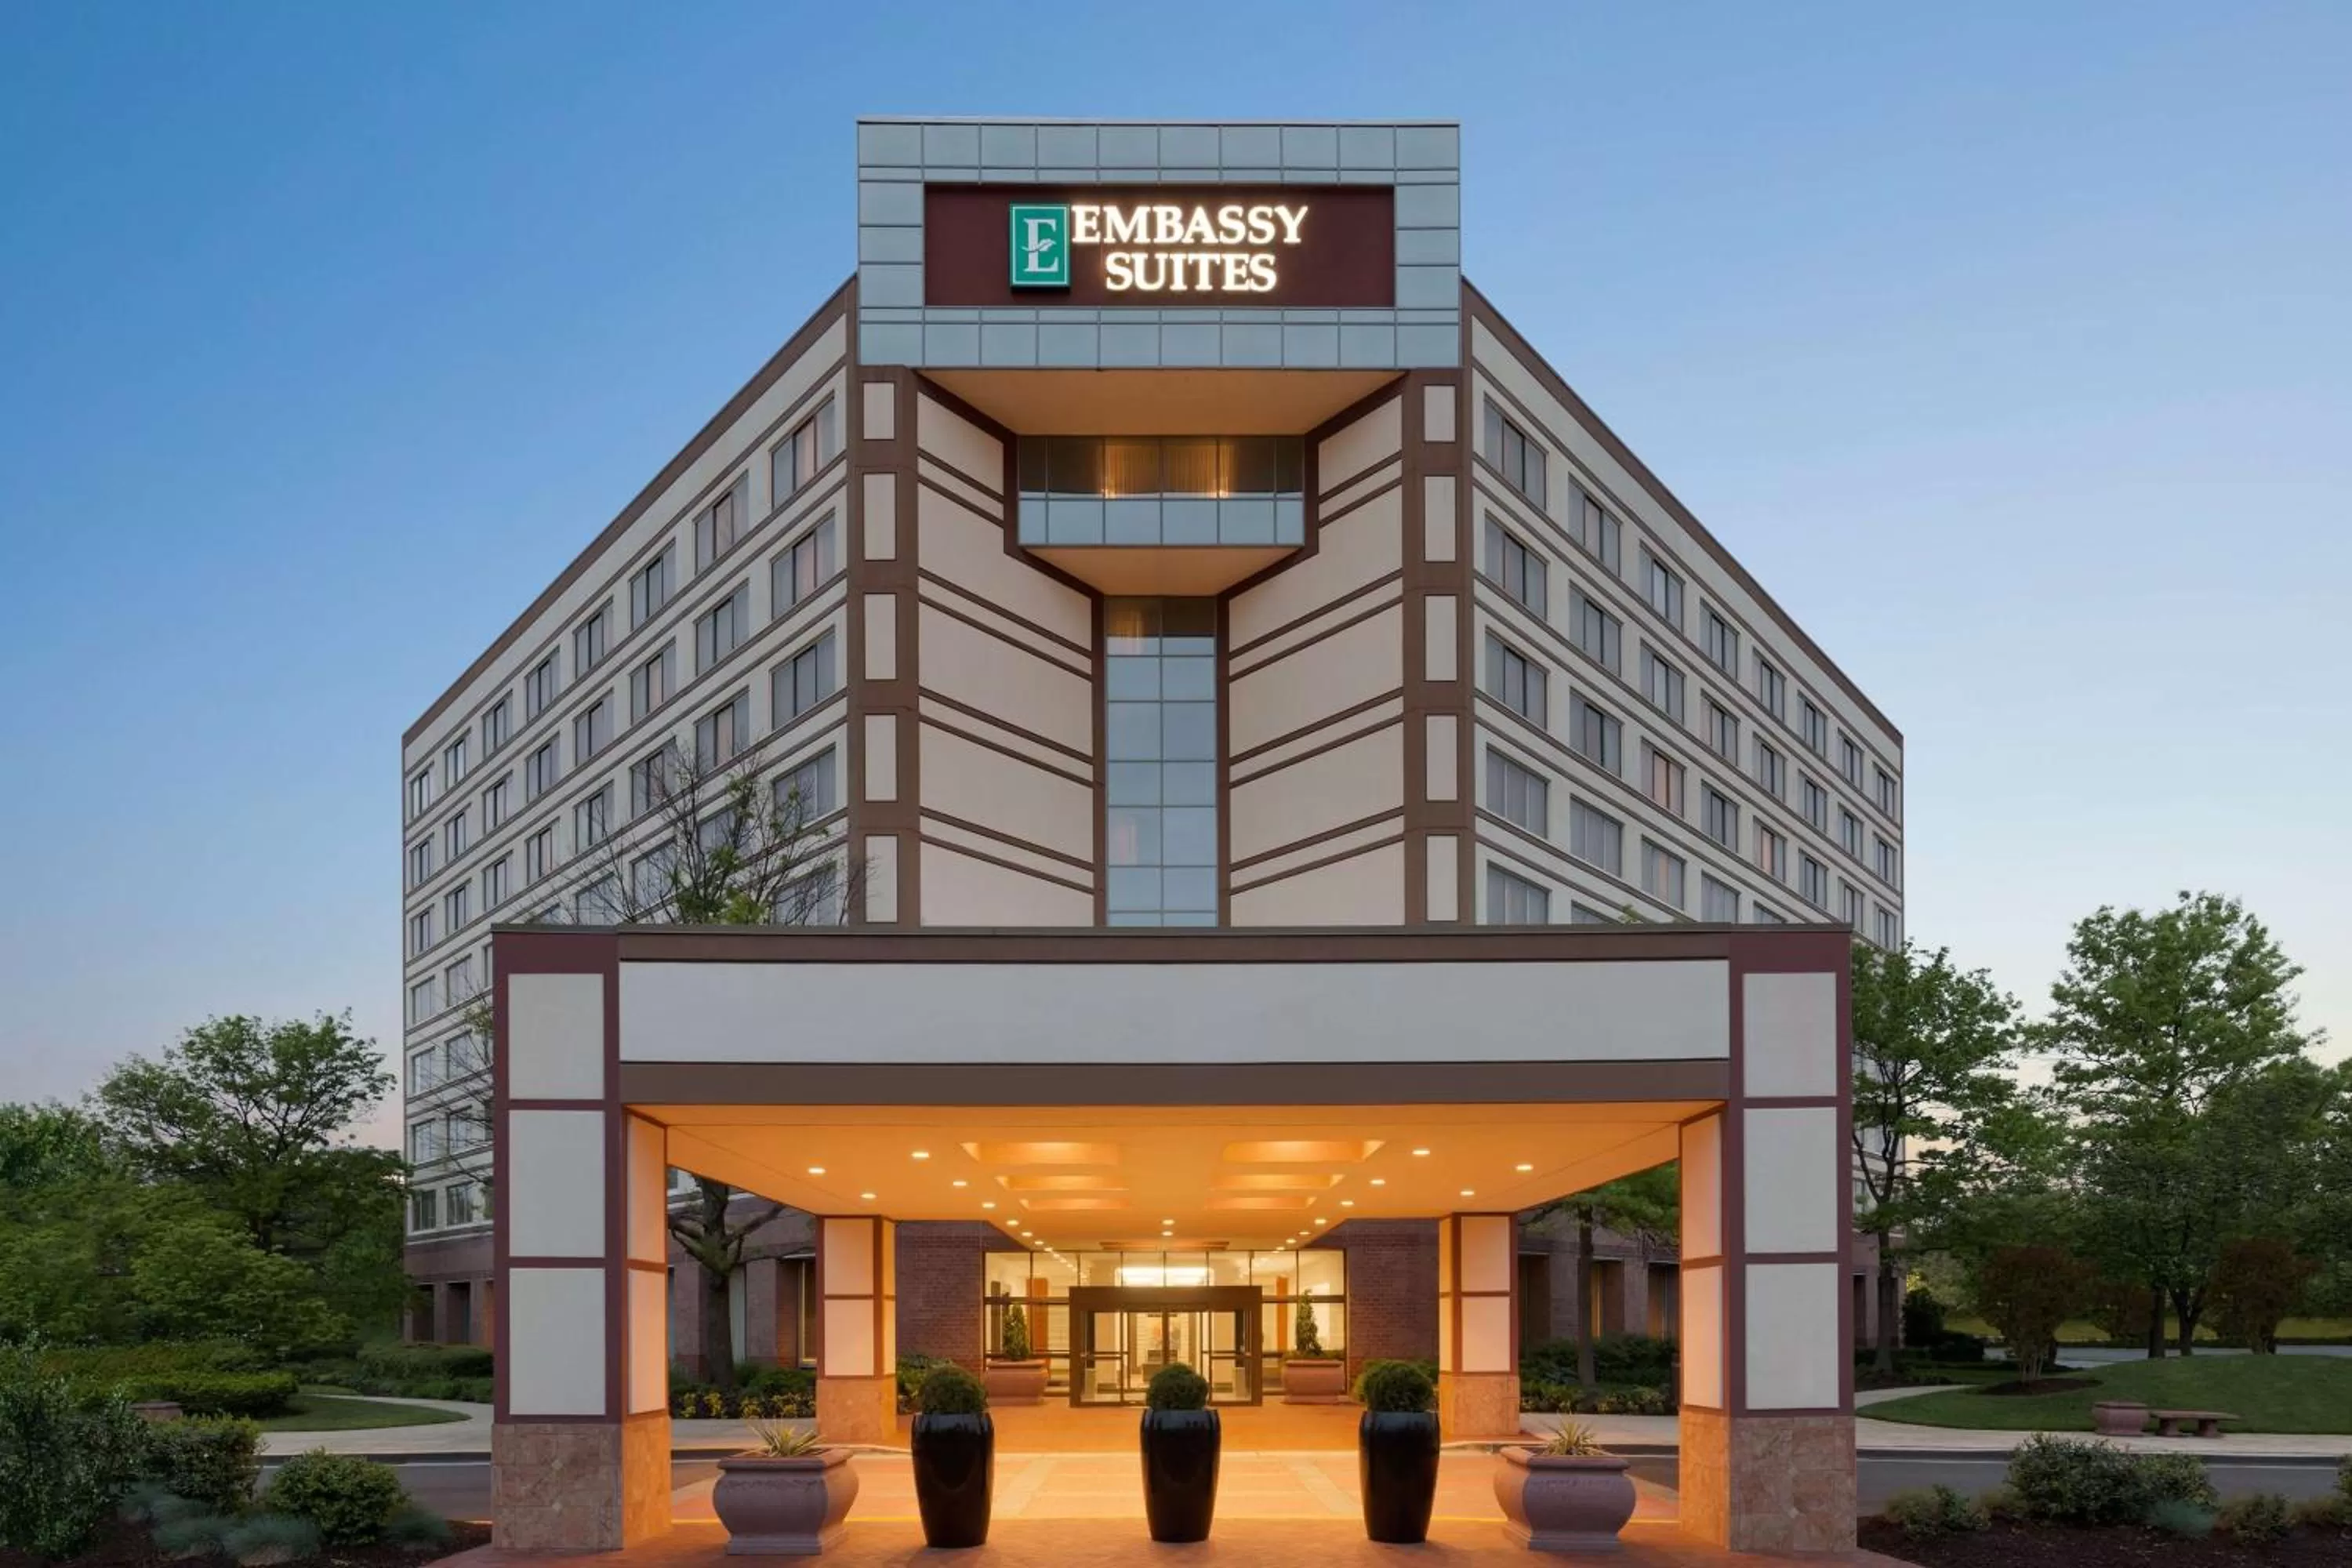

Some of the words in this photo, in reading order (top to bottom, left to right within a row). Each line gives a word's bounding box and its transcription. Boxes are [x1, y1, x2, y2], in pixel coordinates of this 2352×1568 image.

[1022, 217, 1059, 273] E
[1071, 205, 1308, 245] EMBASSY
[1105, 252, 1278, 292] SUITES
